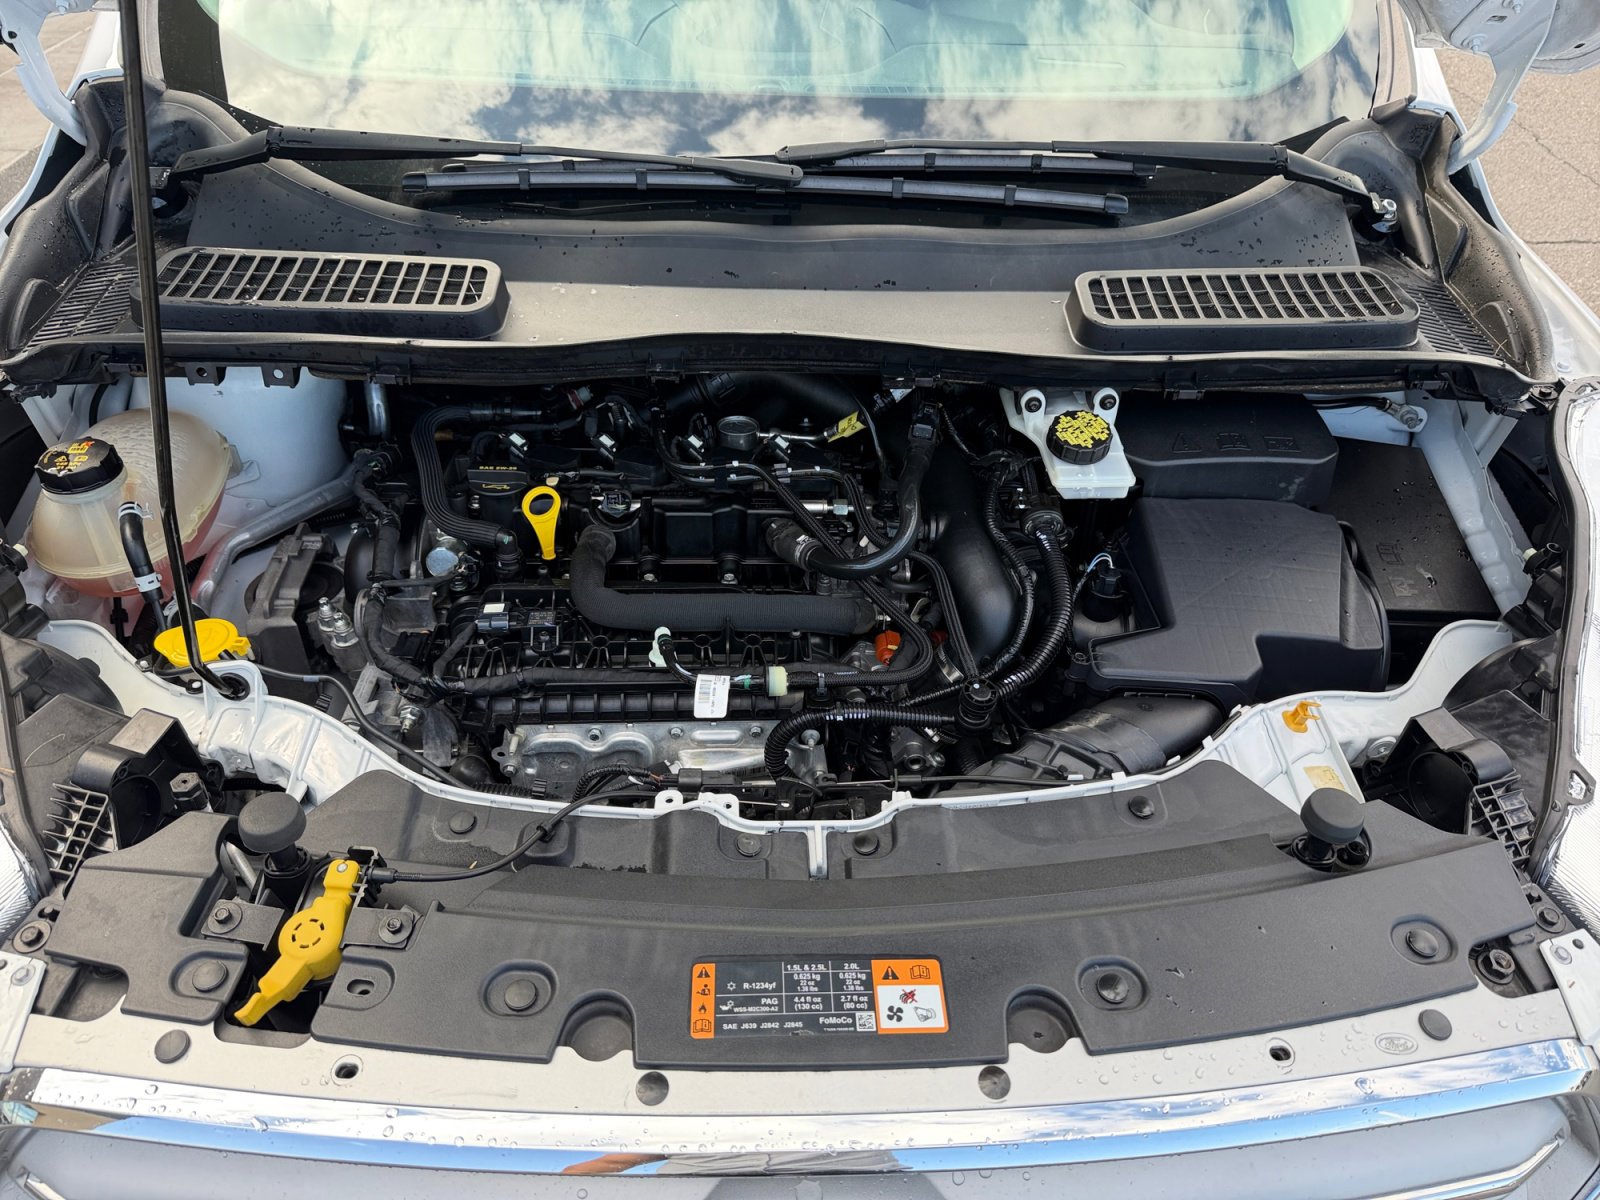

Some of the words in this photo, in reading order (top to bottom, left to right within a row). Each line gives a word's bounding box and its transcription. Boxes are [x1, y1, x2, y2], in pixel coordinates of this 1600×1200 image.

[811, 963, 827, 971] 2.5L
[812, 973, 821, 981] kg
[857, 972, 866, 980] kg
[743, 981, 777, 990] R-1234yf
[761, 997, 779, 1005] PAG
[794, 1003, 810, 1011] (130
[811, 1003, 823, 1011] cc)
[843, 1002, 855, 1010] (80
[855, 1002, 868, 1010] cc)
[819, 1016, 853, 1024] FoMoCo
